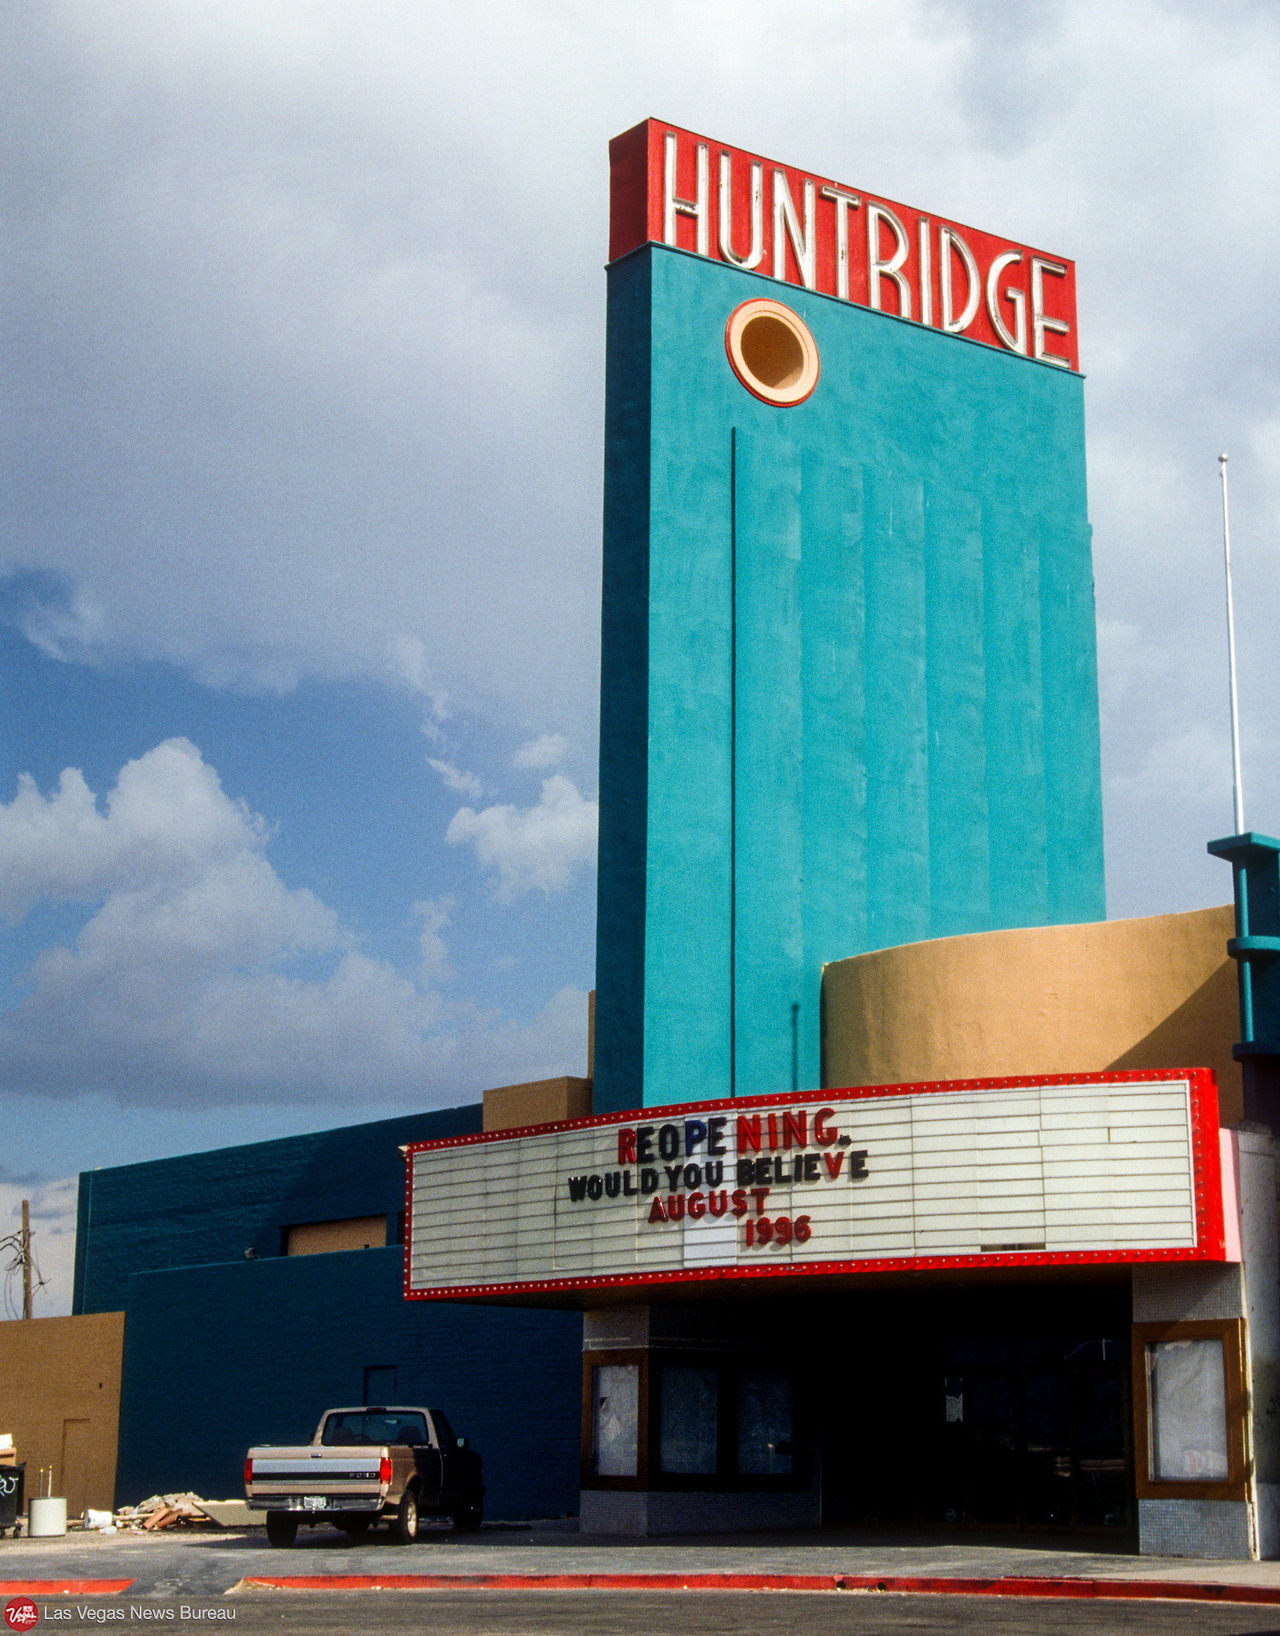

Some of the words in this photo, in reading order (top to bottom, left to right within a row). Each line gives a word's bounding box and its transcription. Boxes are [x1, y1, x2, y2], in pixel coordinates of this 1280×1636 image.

[663, 131, 1071, 368] HUNTRIDGE
[568, 1168, 658, 1202] WOULD
[664, 1160, 723, 1192] YOU
[736, 1149, 869, 1186] BELIEVE
[648, 1188, 770, 1223] AUGUST
[745, 1215, 812, 1247] 1996
